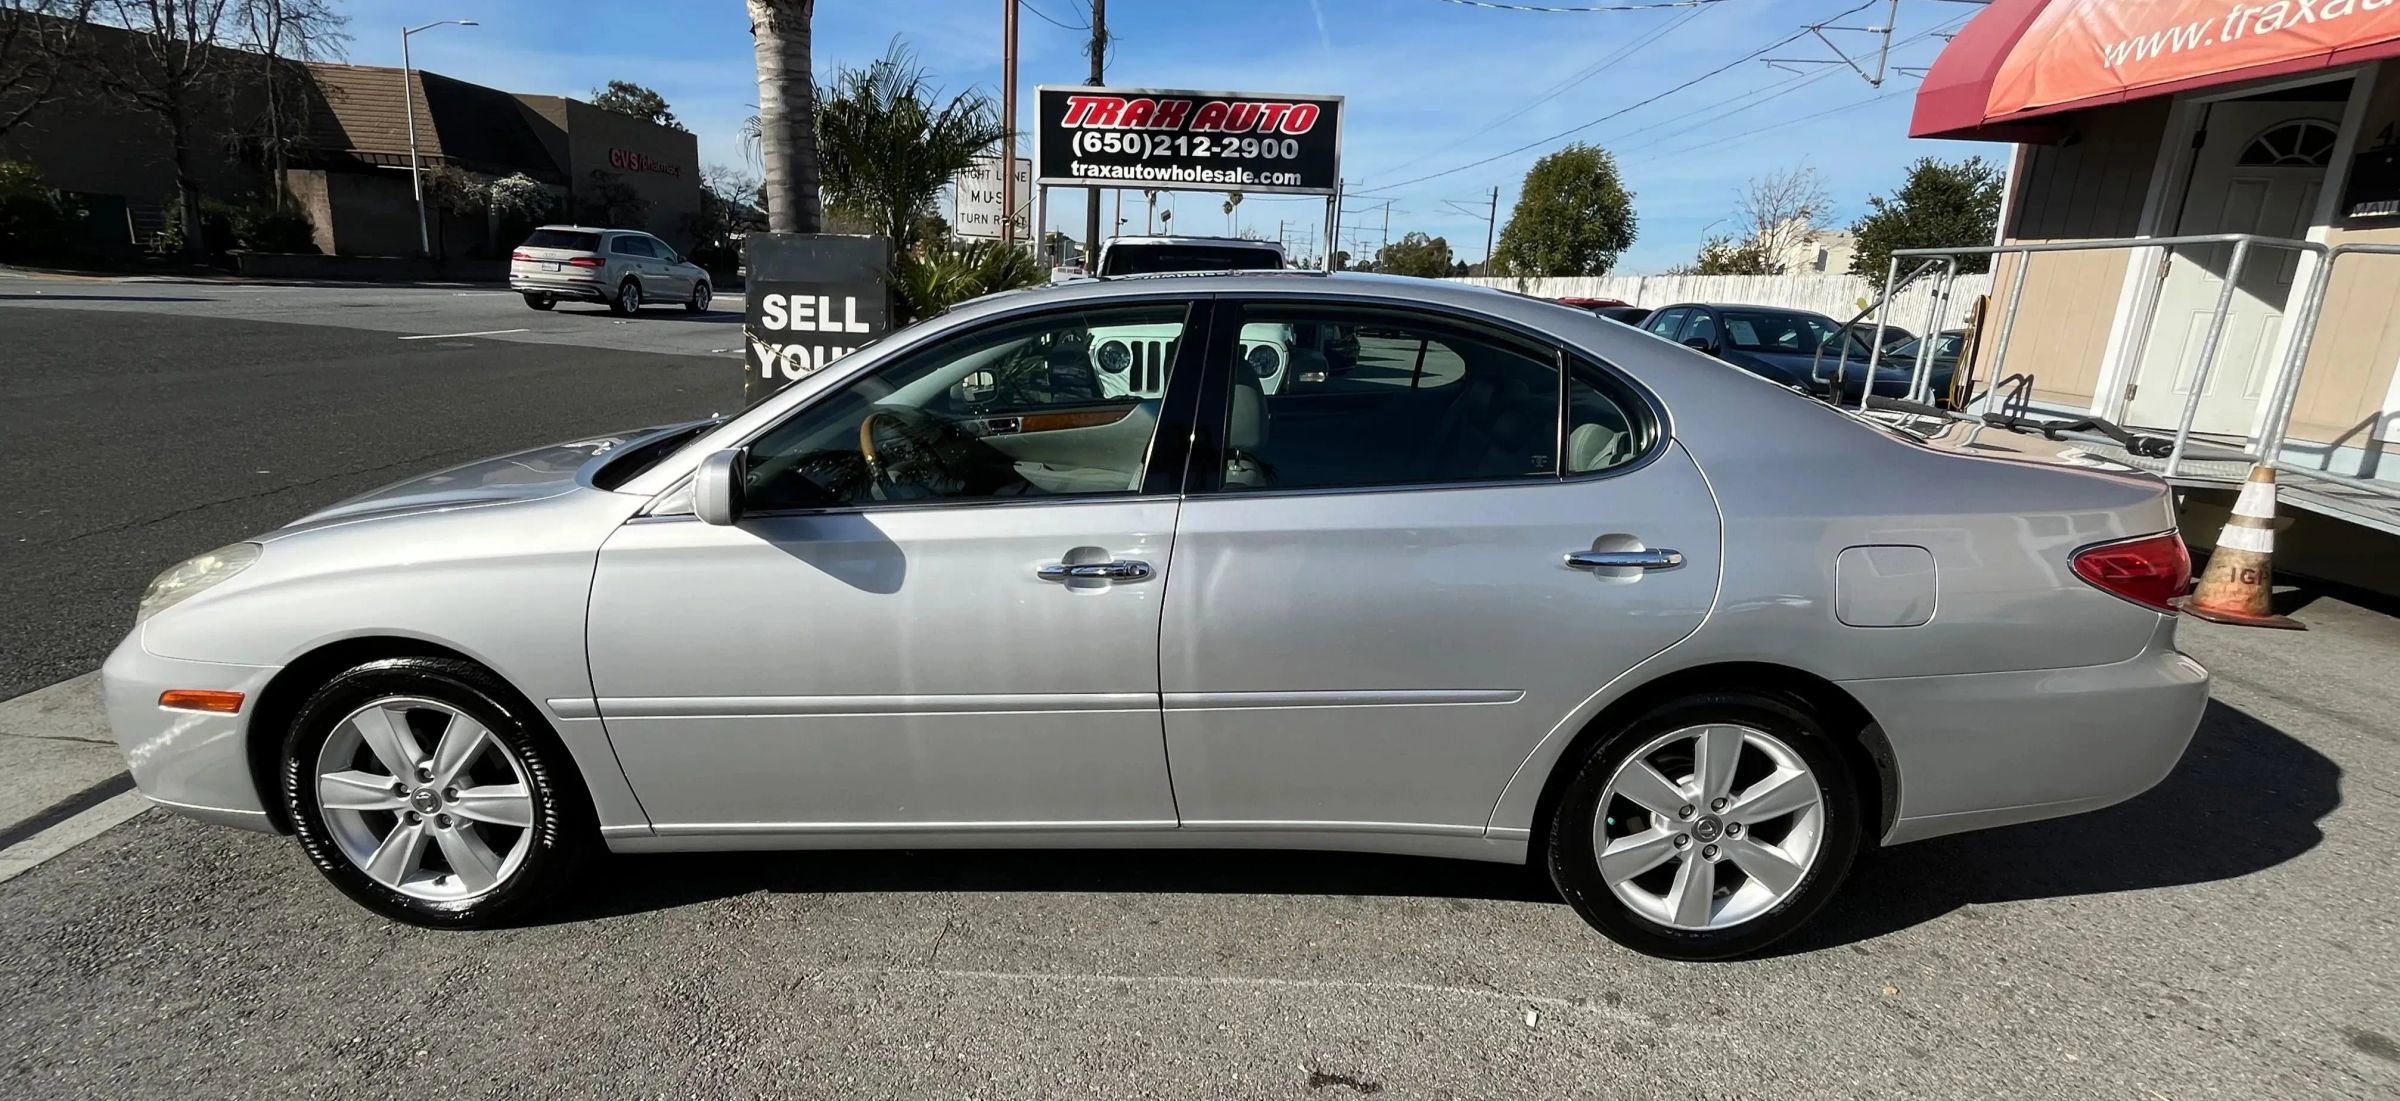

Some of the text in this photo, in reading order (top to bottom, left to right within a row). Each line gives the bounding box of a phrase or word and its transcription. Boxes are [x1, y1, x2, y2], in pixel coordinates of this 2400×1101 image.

[1061, 96, 1320, 135] TRAX AUTO
[1072, 130, 1299, 160] (650)212-2900
[1071, 159, 1301, 186] traxautowholesale.com
[960, 212, 988, 225] TURN
[762, 293, 870, 334] SELL
